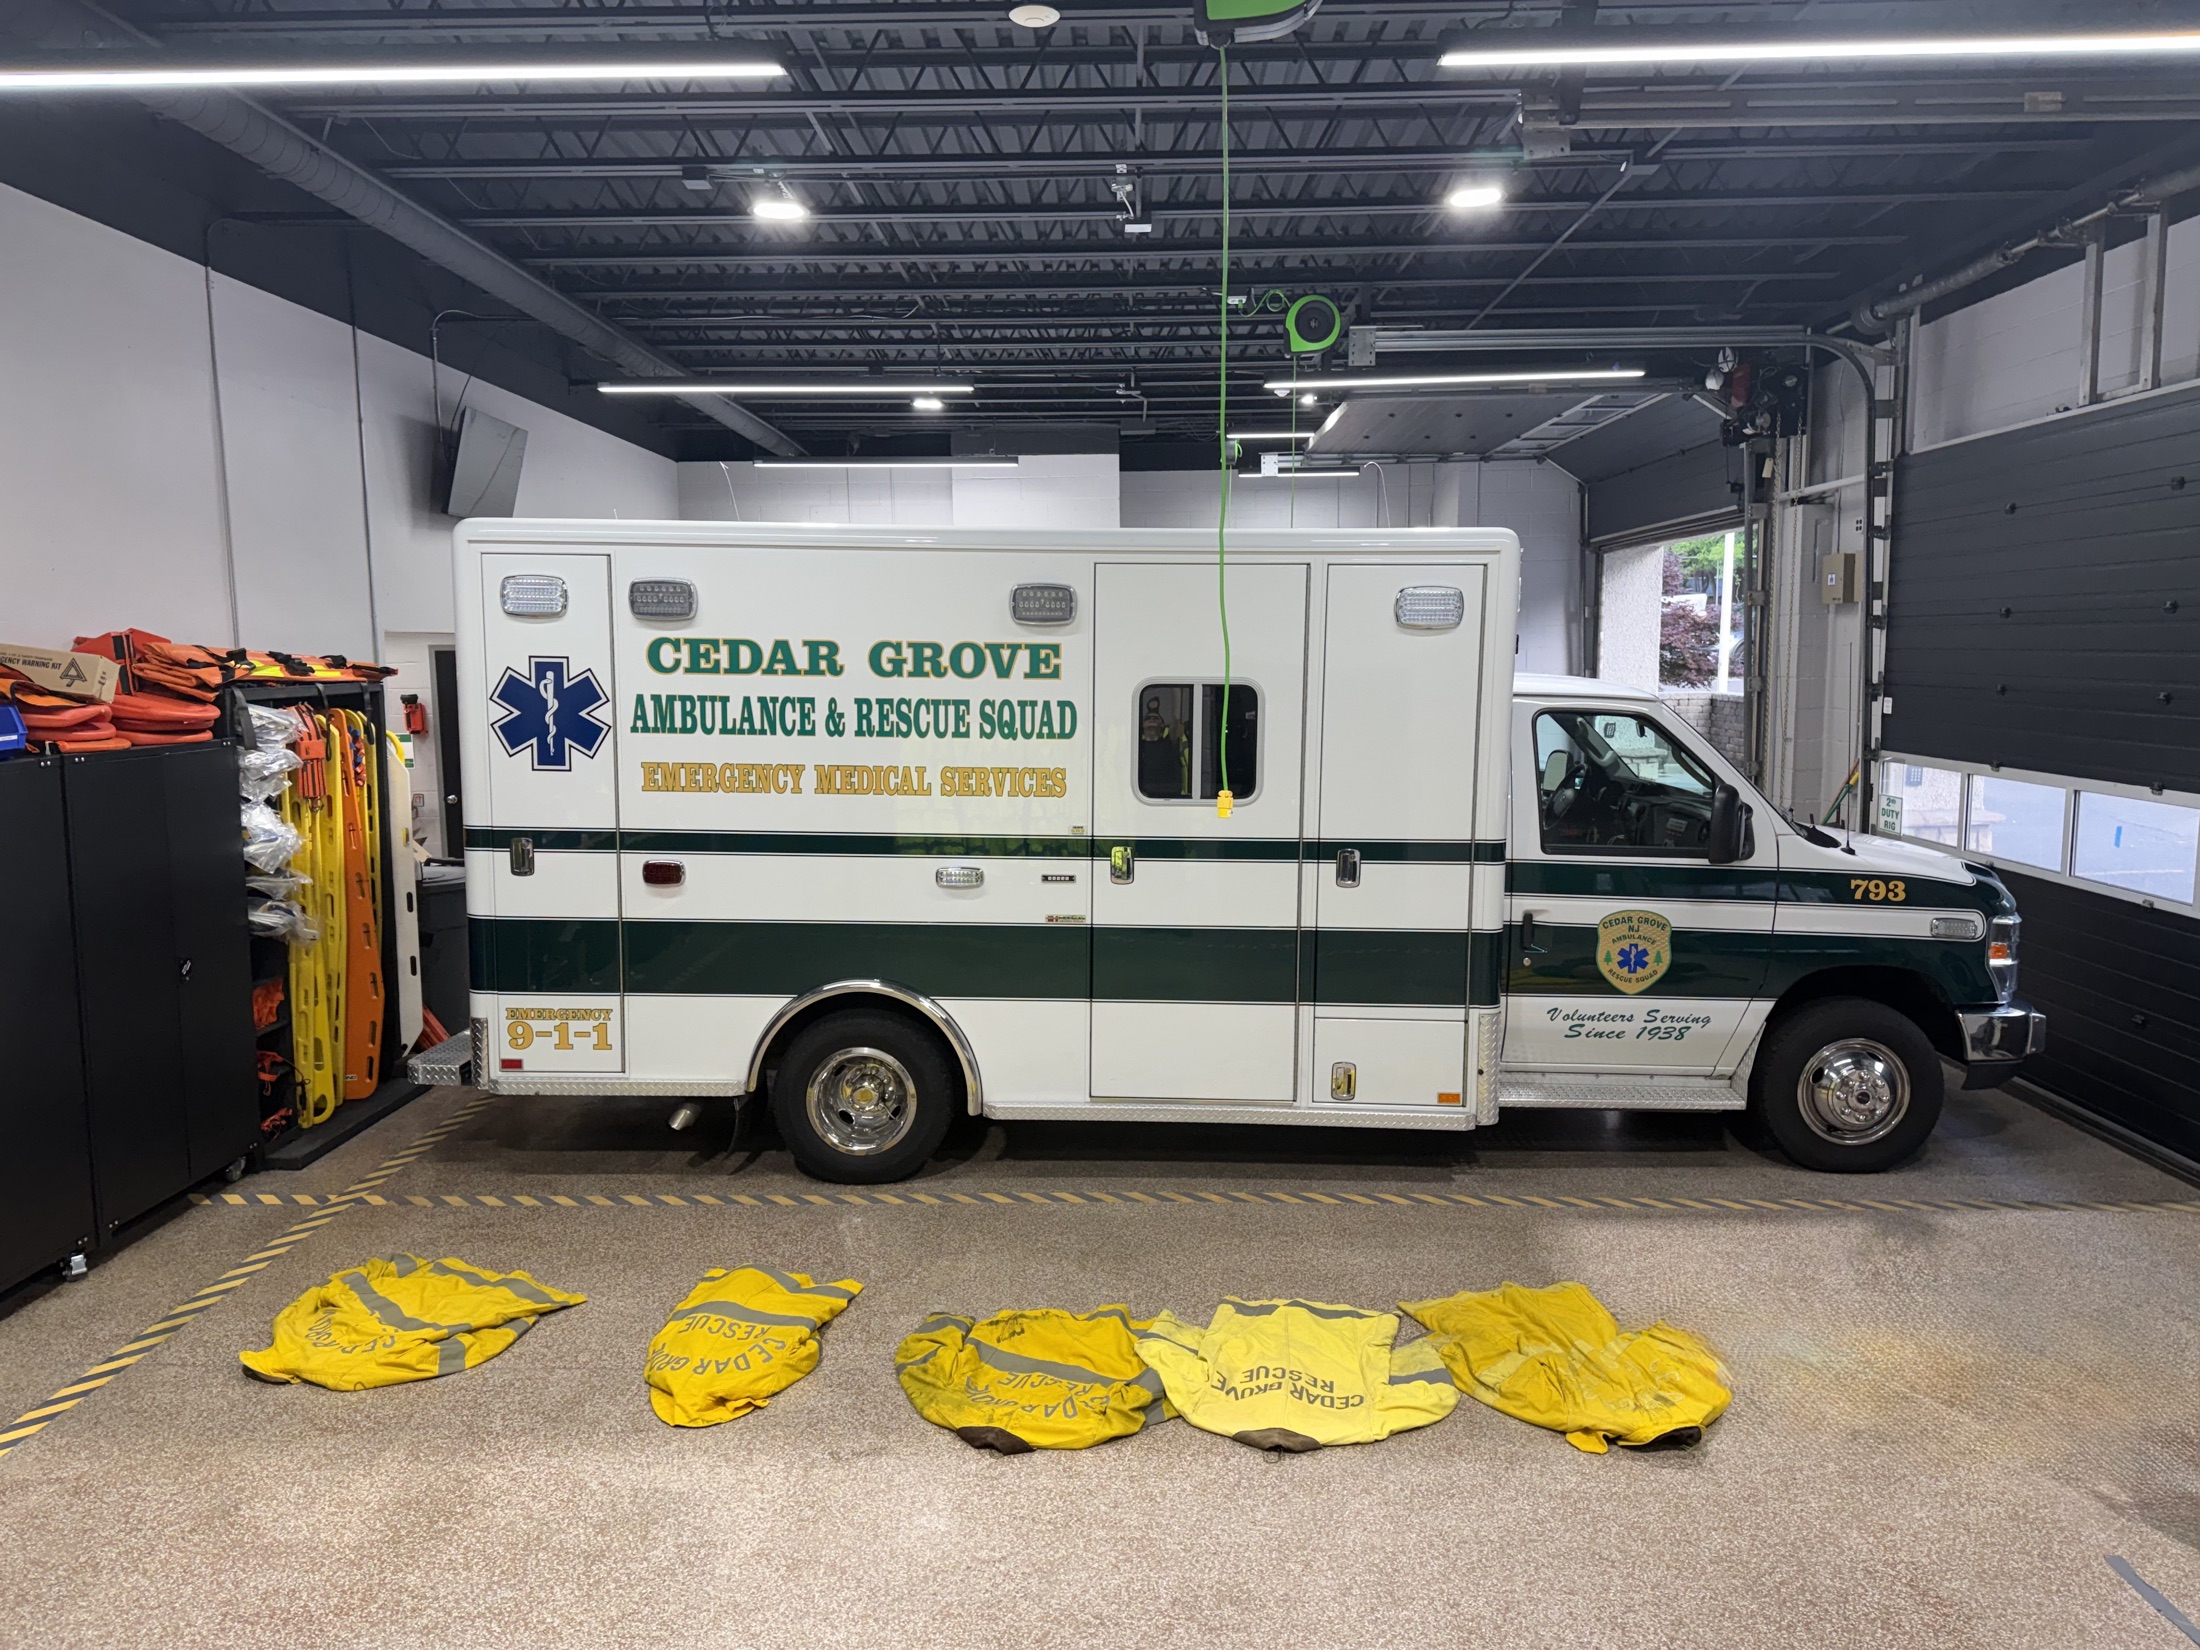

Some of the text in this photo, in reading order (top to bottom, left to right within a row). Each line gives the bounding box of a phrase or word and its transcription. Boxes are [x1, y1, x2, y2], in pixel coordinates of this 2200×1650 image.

[21, 658, 50, 669] WARNING
[51, 662, 62, 670] KIT
[645, 636, 1063, 681] CEDAR GROVE
[630, 694, 1078, 741] AMBULANCE & RESCUE SQUAD
[641, 762, 1068, 799] EMERGENCY MEDICAL SERVICES
[1881, 808, 1900, 820] DUTY
[1883, 820, 1896, 831] RIG
[1850, 879, 1906, 902] 793
[1602, 916, 1668, 931] CEDAR GROVE
[1628, 925, 1640, 933] NJ
[1611, 934, 1657, 946] AMBULANCE
[1608, 968, 1658, 984] RESCUE SQUAD
[505, 1007, 613, 1021] EMERGENCY
[1546, 1007, 1712, 1029] Volunteers Serving
[507, 1020, 613, 1050] 9-1-1
[1564, 1023, 1692, 1041] Since 1938
[677, 1314, 772, 1341] RESCUE
[692, 1337, 787, 1376] CEDAR
[1210, 1370, 1365, 1410] CEDAR GROVE
[1239, 1365, 1335, 1394] RESCUE
